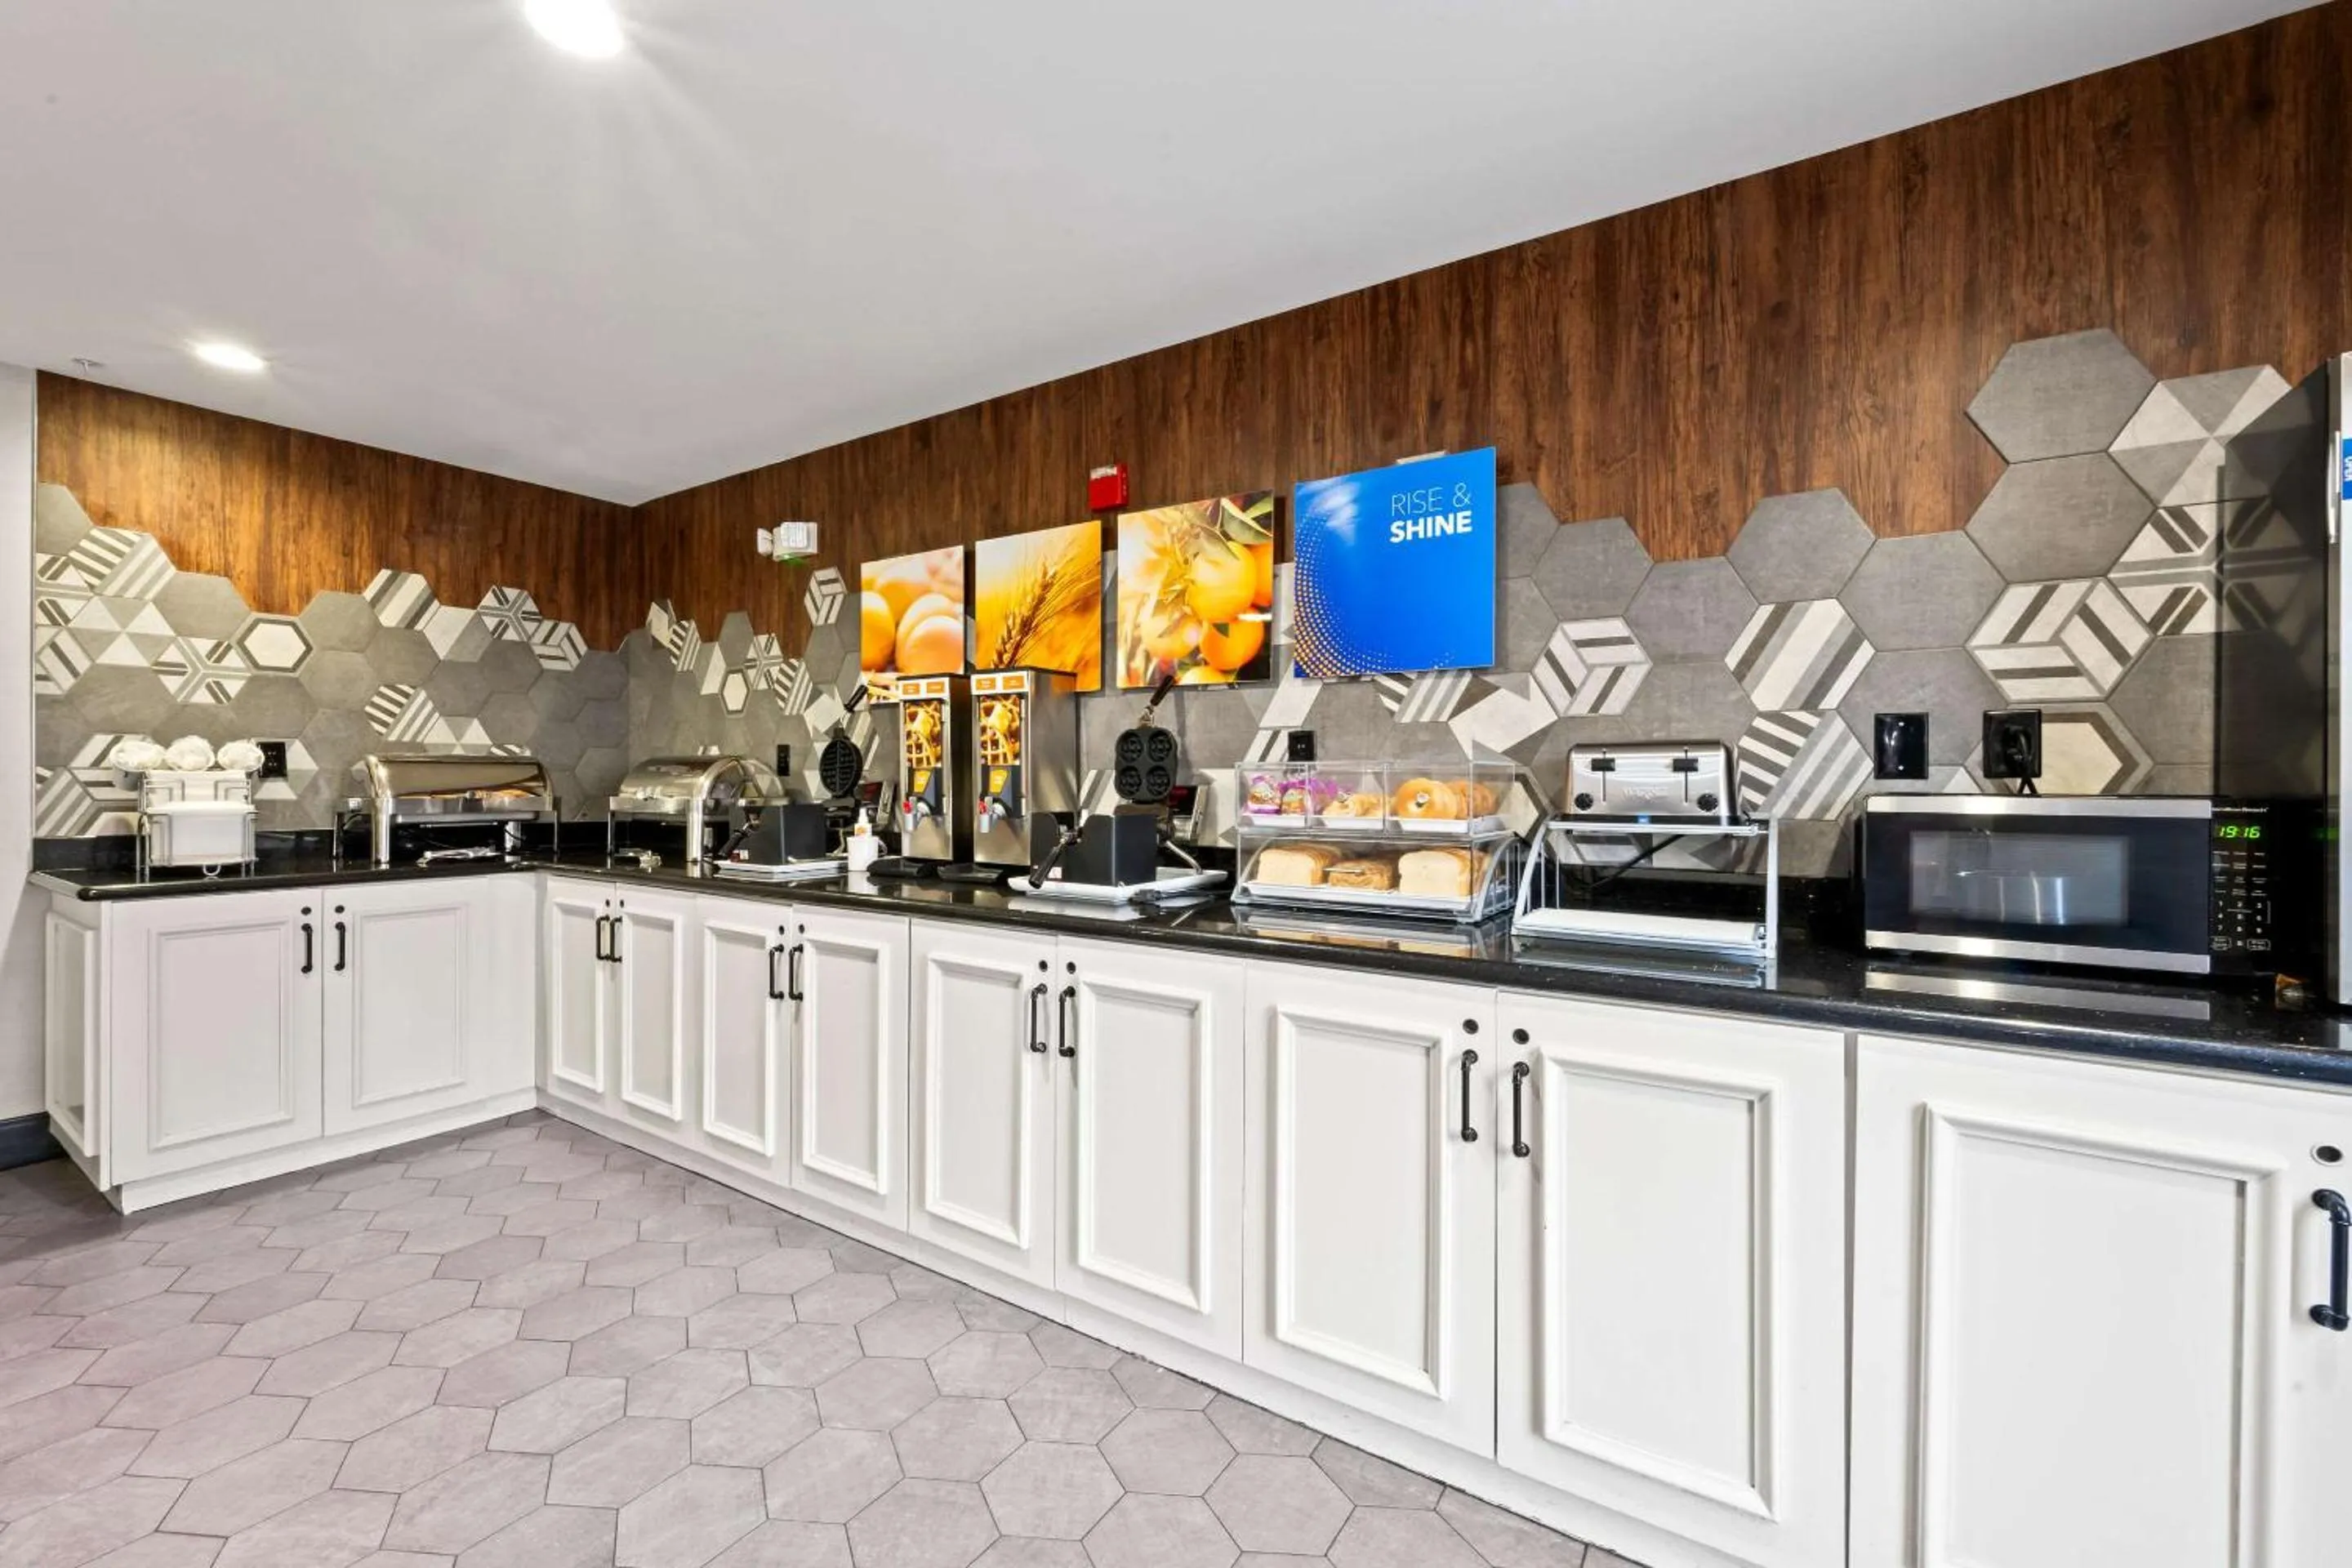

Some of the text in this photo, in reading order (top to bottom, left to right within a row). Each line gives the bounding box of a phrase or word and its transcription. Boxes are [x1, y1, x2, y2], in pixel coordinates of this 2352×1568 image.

[1391, 482, 1472, 517] RISE &
[1389, 510, 1472, 544] SHINE
